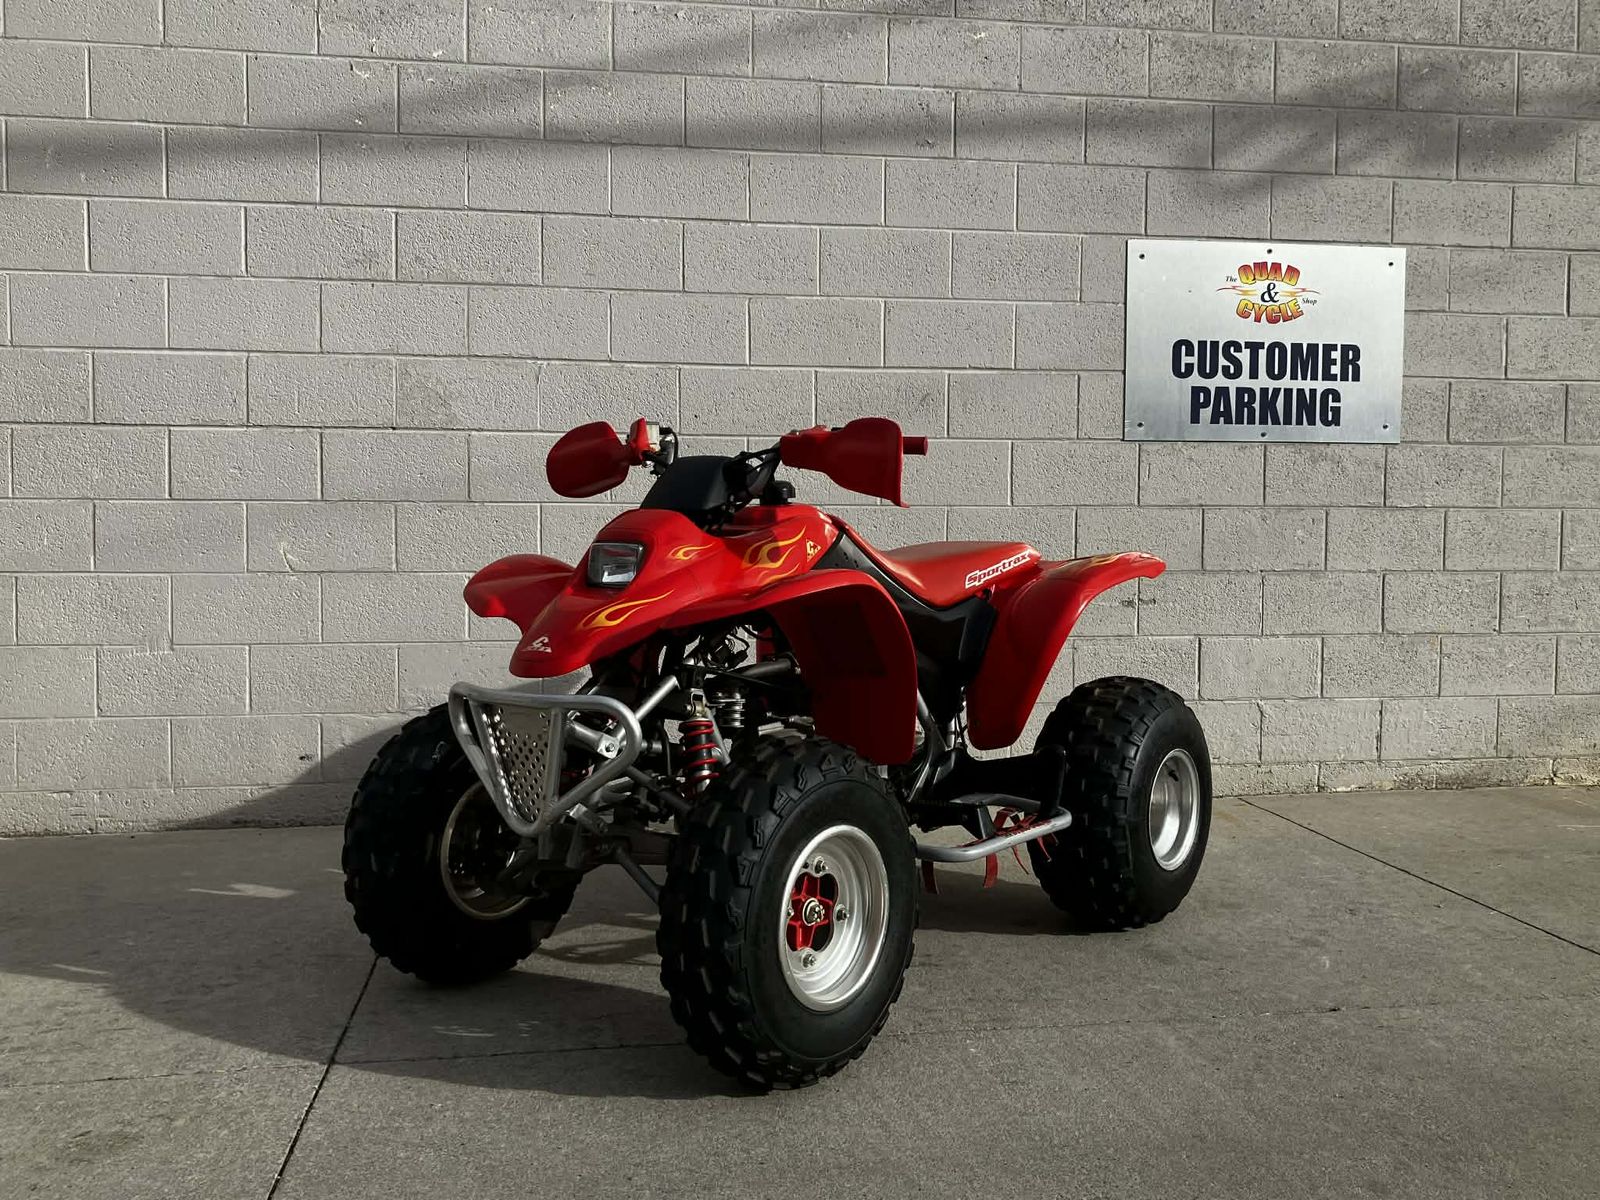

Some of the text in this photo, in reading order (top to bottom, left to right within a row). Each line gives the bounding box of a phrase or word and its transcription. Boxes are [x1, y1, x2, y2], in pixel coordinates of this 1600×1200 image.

[1237, 261, 1300, 286] QUAD
[1260, 282, 1279, 303] &
[1302, 297, 1318, 306] Shop
[1236, 298, 1304, 324] CYCLE
[1171, 338, 1361, 382] CUSTOMER
[1190, 385, 1342, 427] PARKING
[965, 548, 1031, 589] Sportrax
